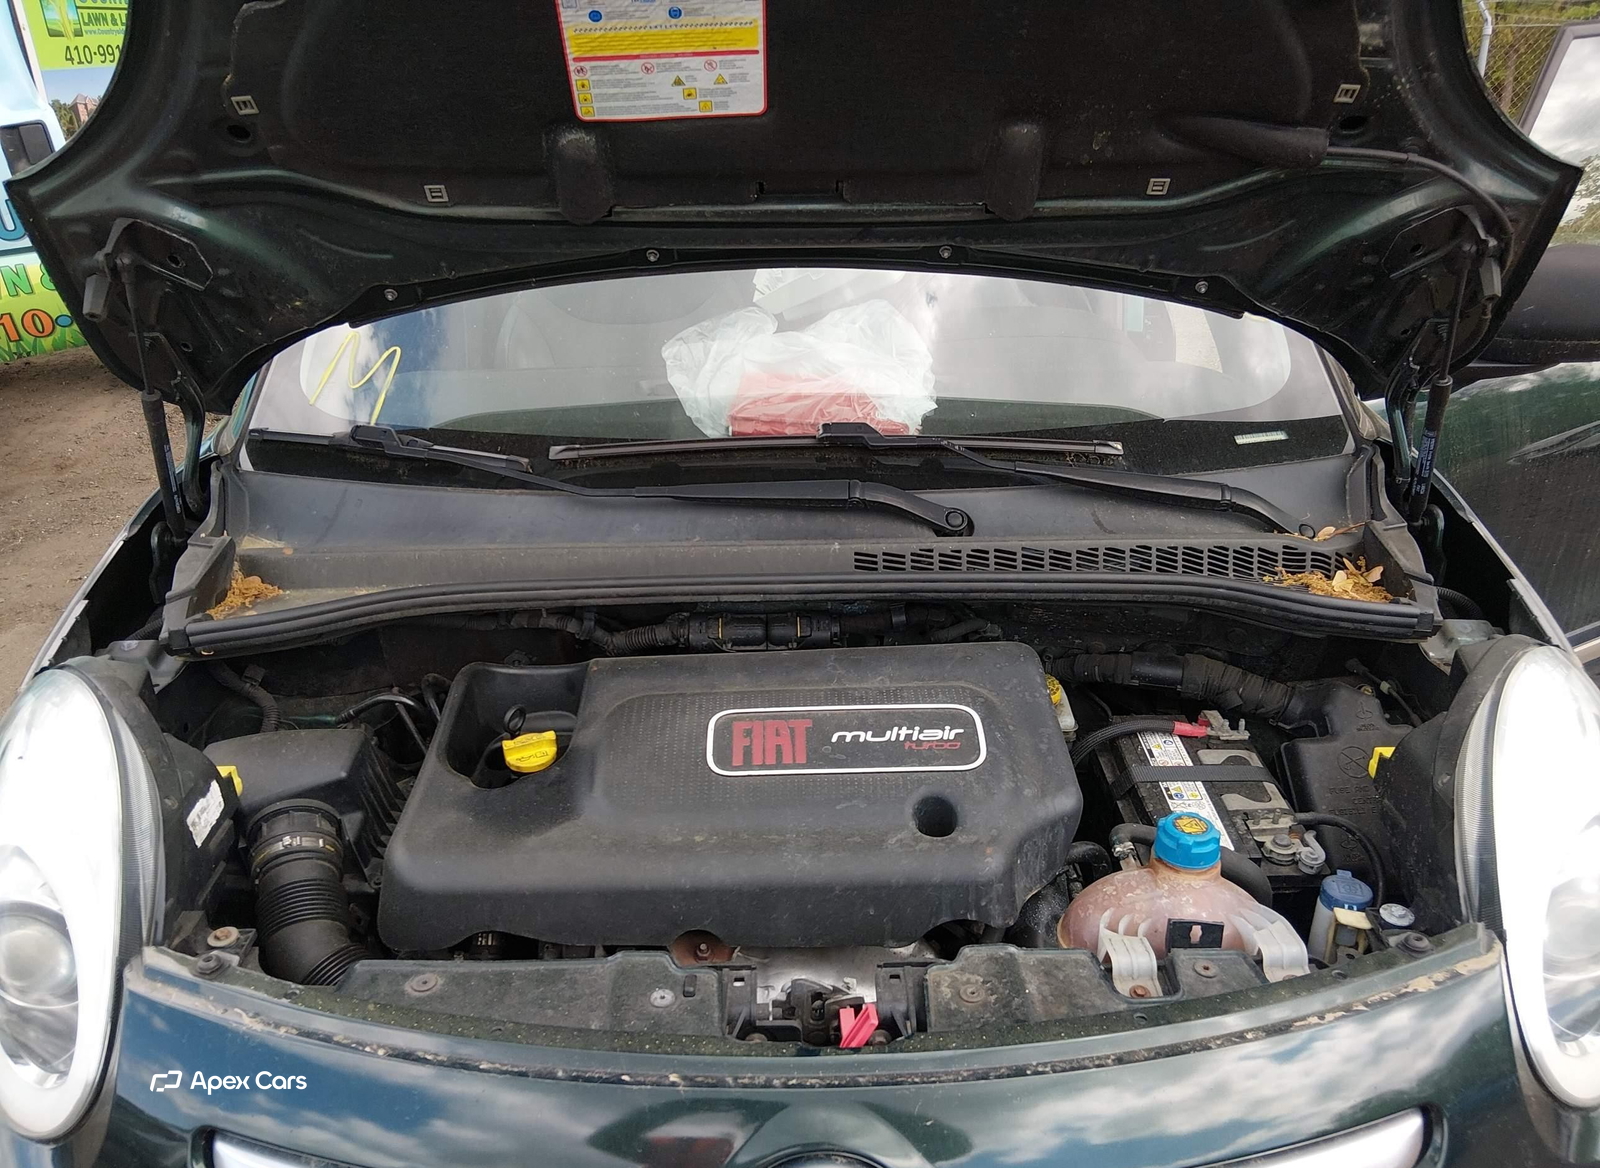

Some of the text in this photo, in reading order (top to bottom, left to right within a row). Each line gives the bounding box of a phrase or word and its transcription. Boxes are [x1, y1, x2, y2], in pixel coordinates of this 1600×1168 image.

[80, 12, 128, 26] LAWN & L
[831, 726, 964, 743] multiair
[731, 719, 813, 766] FIAT
[904, 740, 961, 750] turbo
